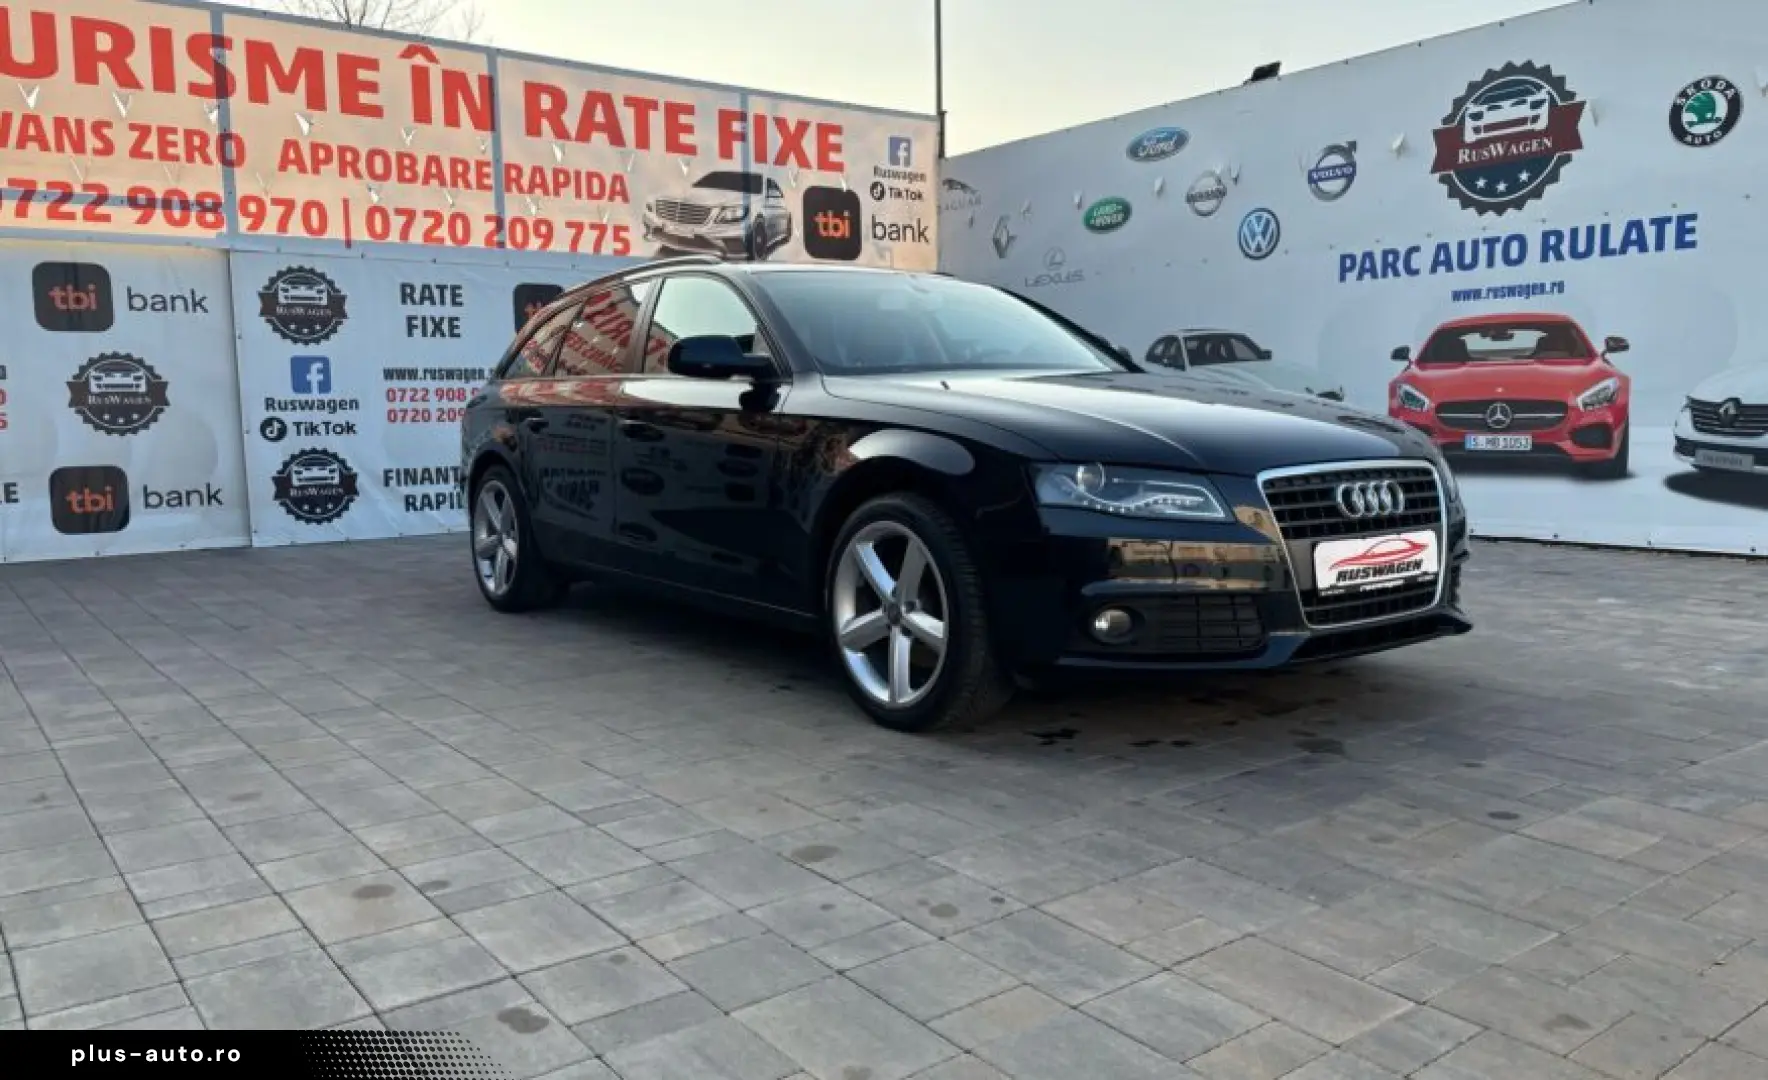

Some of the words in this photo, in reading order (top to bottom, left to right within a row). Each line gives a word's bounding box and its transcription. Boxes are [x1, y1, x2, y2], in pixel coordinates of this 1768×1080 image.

[398, 44, 495, 131] ÎN
[523, 80, 698, 156] RATE
[718, 108, 845, 172] FIXE
[129, 122, 246, 168] ZERO
[278, 138, 493, 191] APROBARE
[505, 163, 630, 204] RAPIDA
[1312, 165, 1353, 181] VOLVO
[873, 165, 927, 184] Ruswagen
[889, 187, 923, 201] TikTok
[0, 177, 112, 223] 722
[127, 186, 226, 229] 908
[238, 195, 329, 236] 970
[365, 204, 471, 246] 0720
[484, 215, 554, 251] 209
[565, 220, 631, 257] 775
[813, 210, 850, 239] tbi
[871, 213, 930, 243] bank
[1339, 246, 1421, 283] PARC
[1429, 233, 1528, 275] AUTO
[1540, 213, 1698, 264] RULATE
[1024, 269, 1086, 287] LEXUS
[48, 283, 98, 311] tbi
[127, 286, 208, 313] bank
[401, 283, 464, 307] RATE
[1452, 281, 1565, 302] www.ruswagen.ro
[406, 315, 461, 338] FIXE
[265, 397, 359, 414] Ruswagen
[386, 388, 430, 402] 0722
[435, 388, 466, 402] 908
[387, 408, 431, 423] 0720
[292, 421, 357, 436] TikTok
[65, 486, 114, 514] tbi
[143, 483, 225, 509] bank
